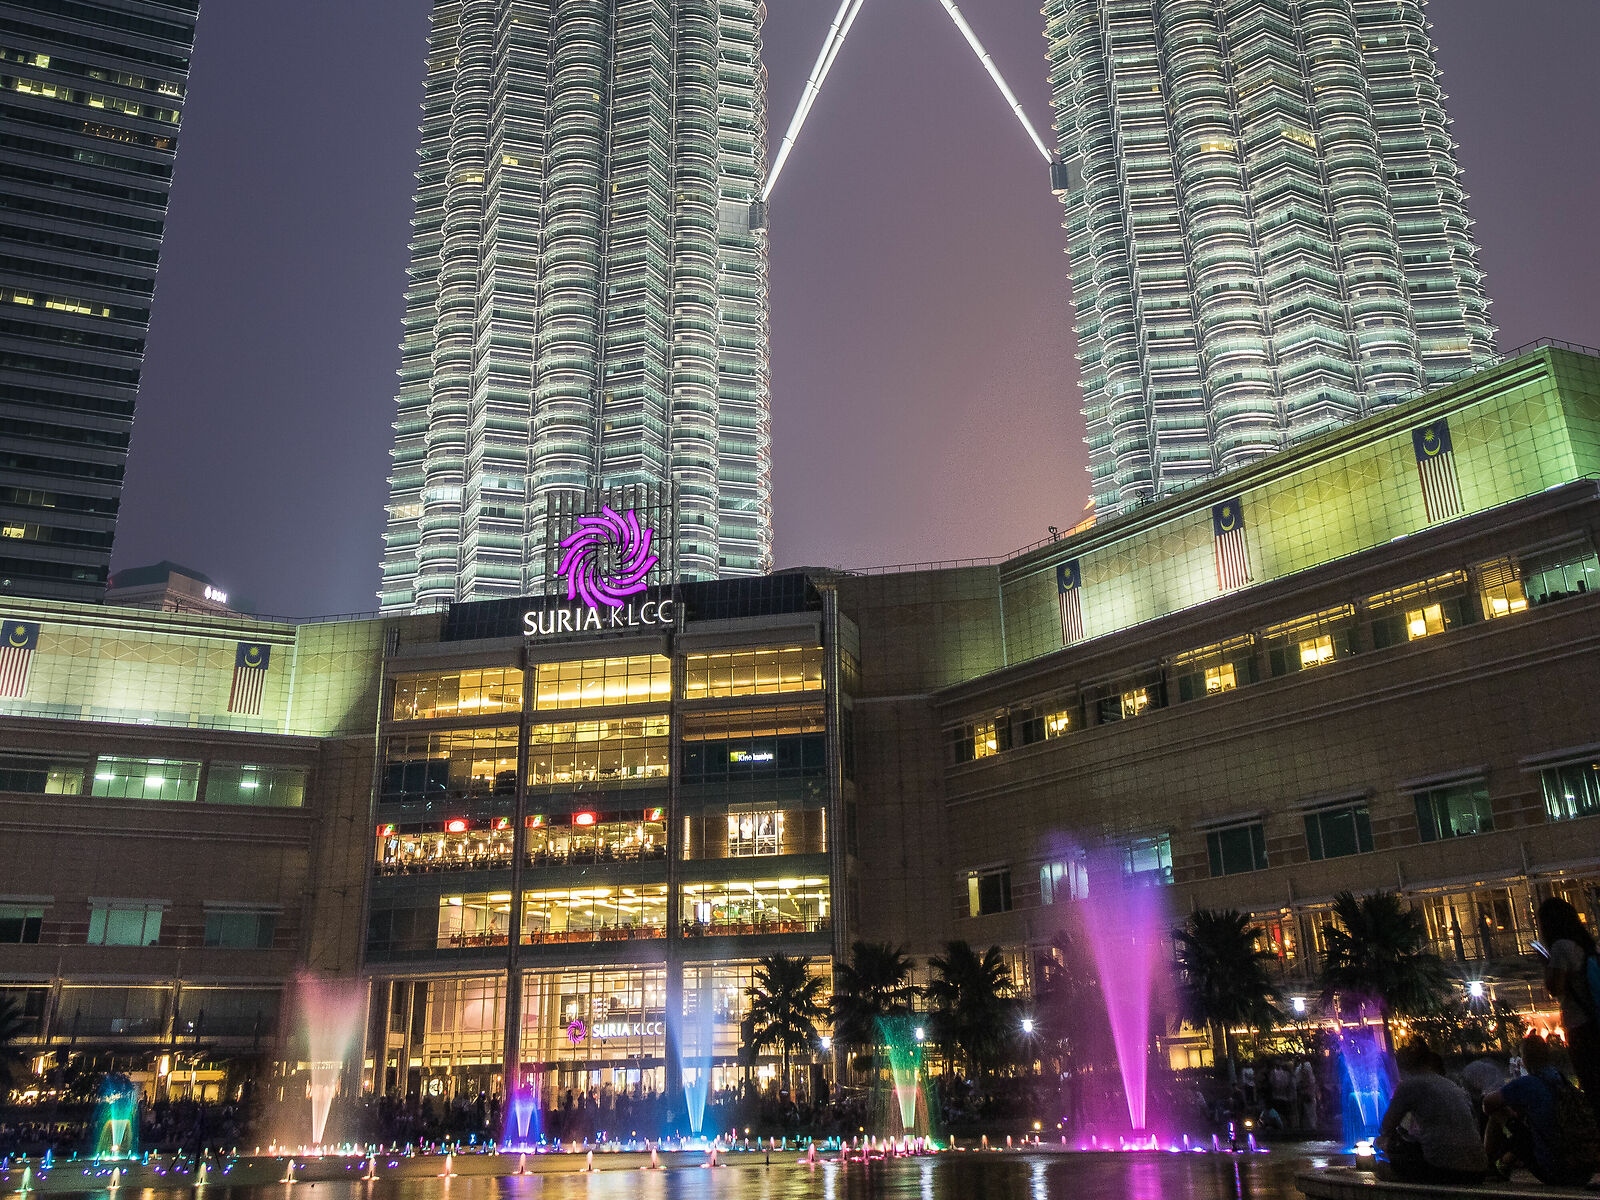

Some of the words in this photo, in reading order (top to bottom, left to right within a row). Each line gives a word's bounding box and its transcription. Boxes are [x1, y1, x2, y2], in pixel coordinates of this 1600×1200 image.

[523, 606, 602, 636] SURIA
[611, 600, 674, 628] KLCC
[592, 1023, 630, 1038] SURIA
[633, 1022, 663, 1036] KLCC
